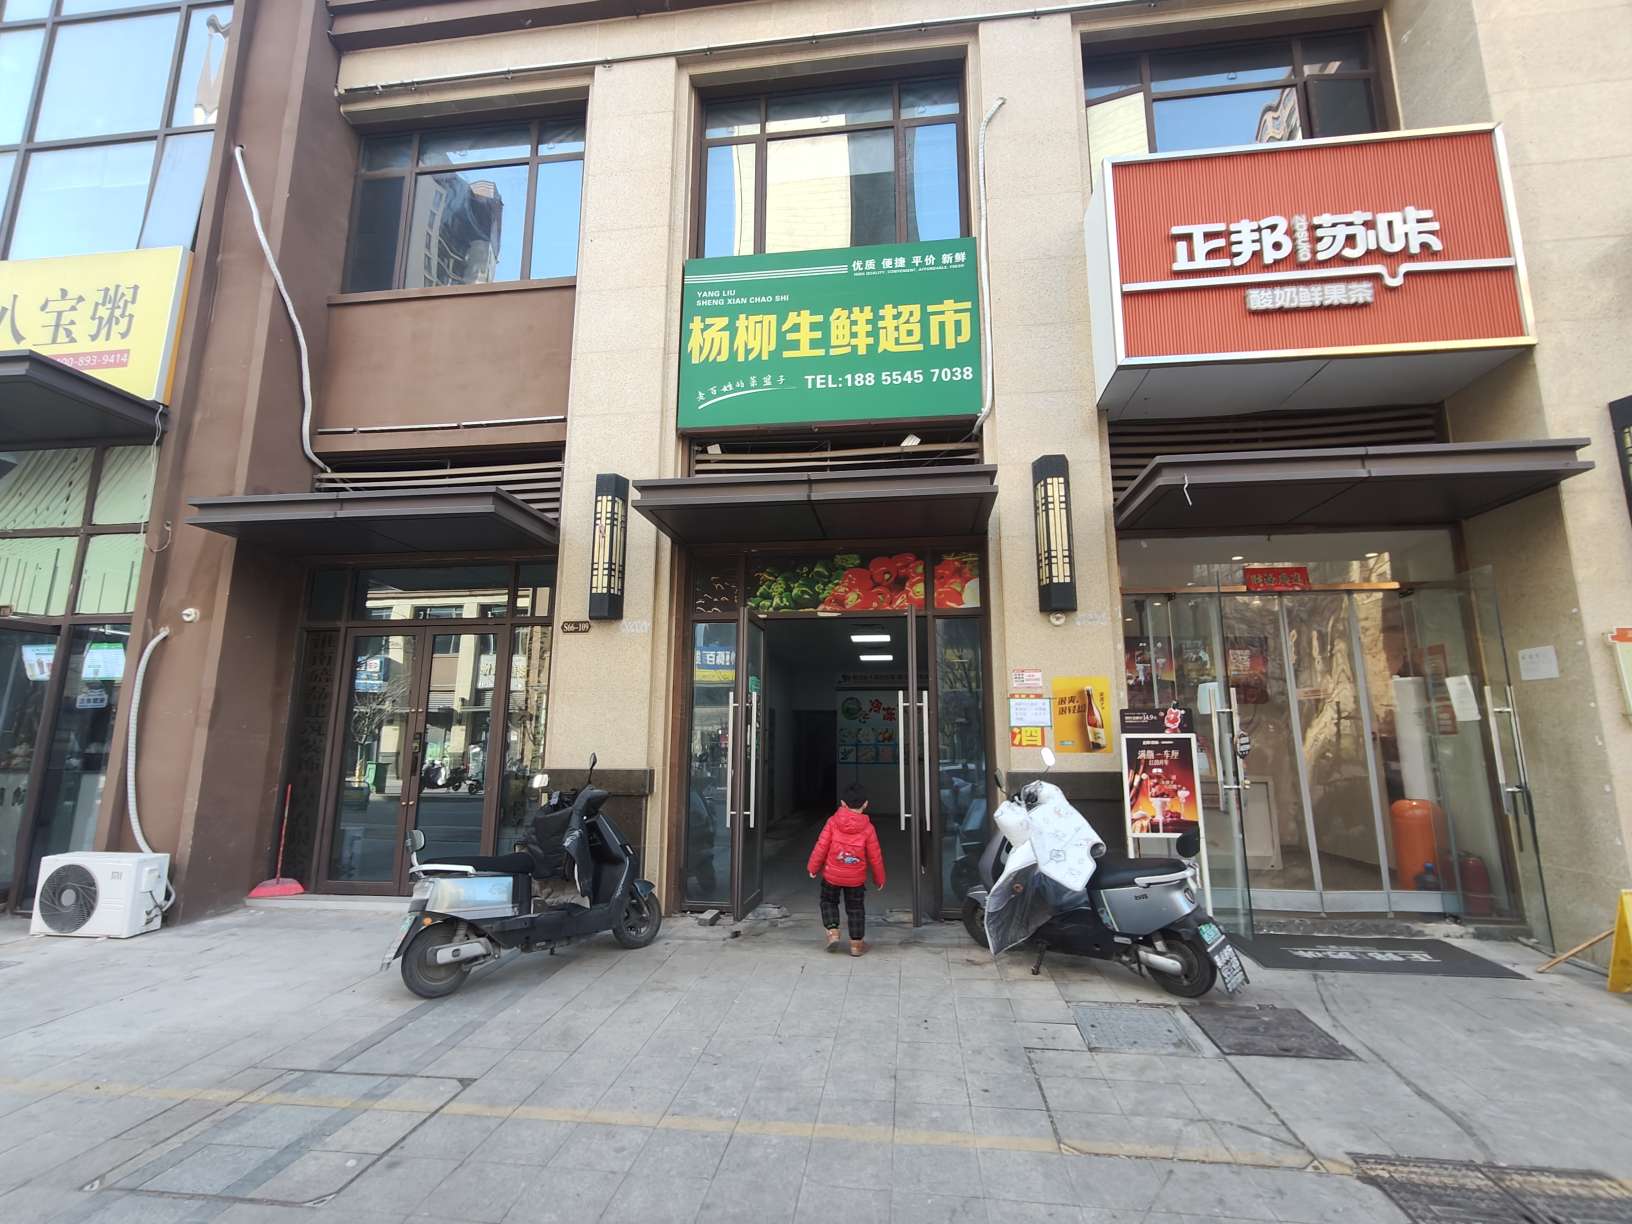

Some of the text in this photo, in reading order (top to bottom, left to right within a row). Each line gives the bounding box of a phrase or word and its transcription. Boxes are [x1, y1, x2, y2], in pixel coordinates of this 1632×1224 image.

[1170, 215, 1293, 272] 正邦
[852, 251, 967, 271] 优质 便捷 平价 新鲜
[697, 289, 736, 298] YANG LIU
[727, 297, 747, 305] XIAN
[749, 296, 772, 304] CHAO
[775, 294, 789, 302] SHI
[1246, 281, 1374, 311] 酸奶鲜果茶
[687, 299, 973, 365] 杨柳生鲜超市
[805, 366, 974, 389] TEL:188 5545 7038
